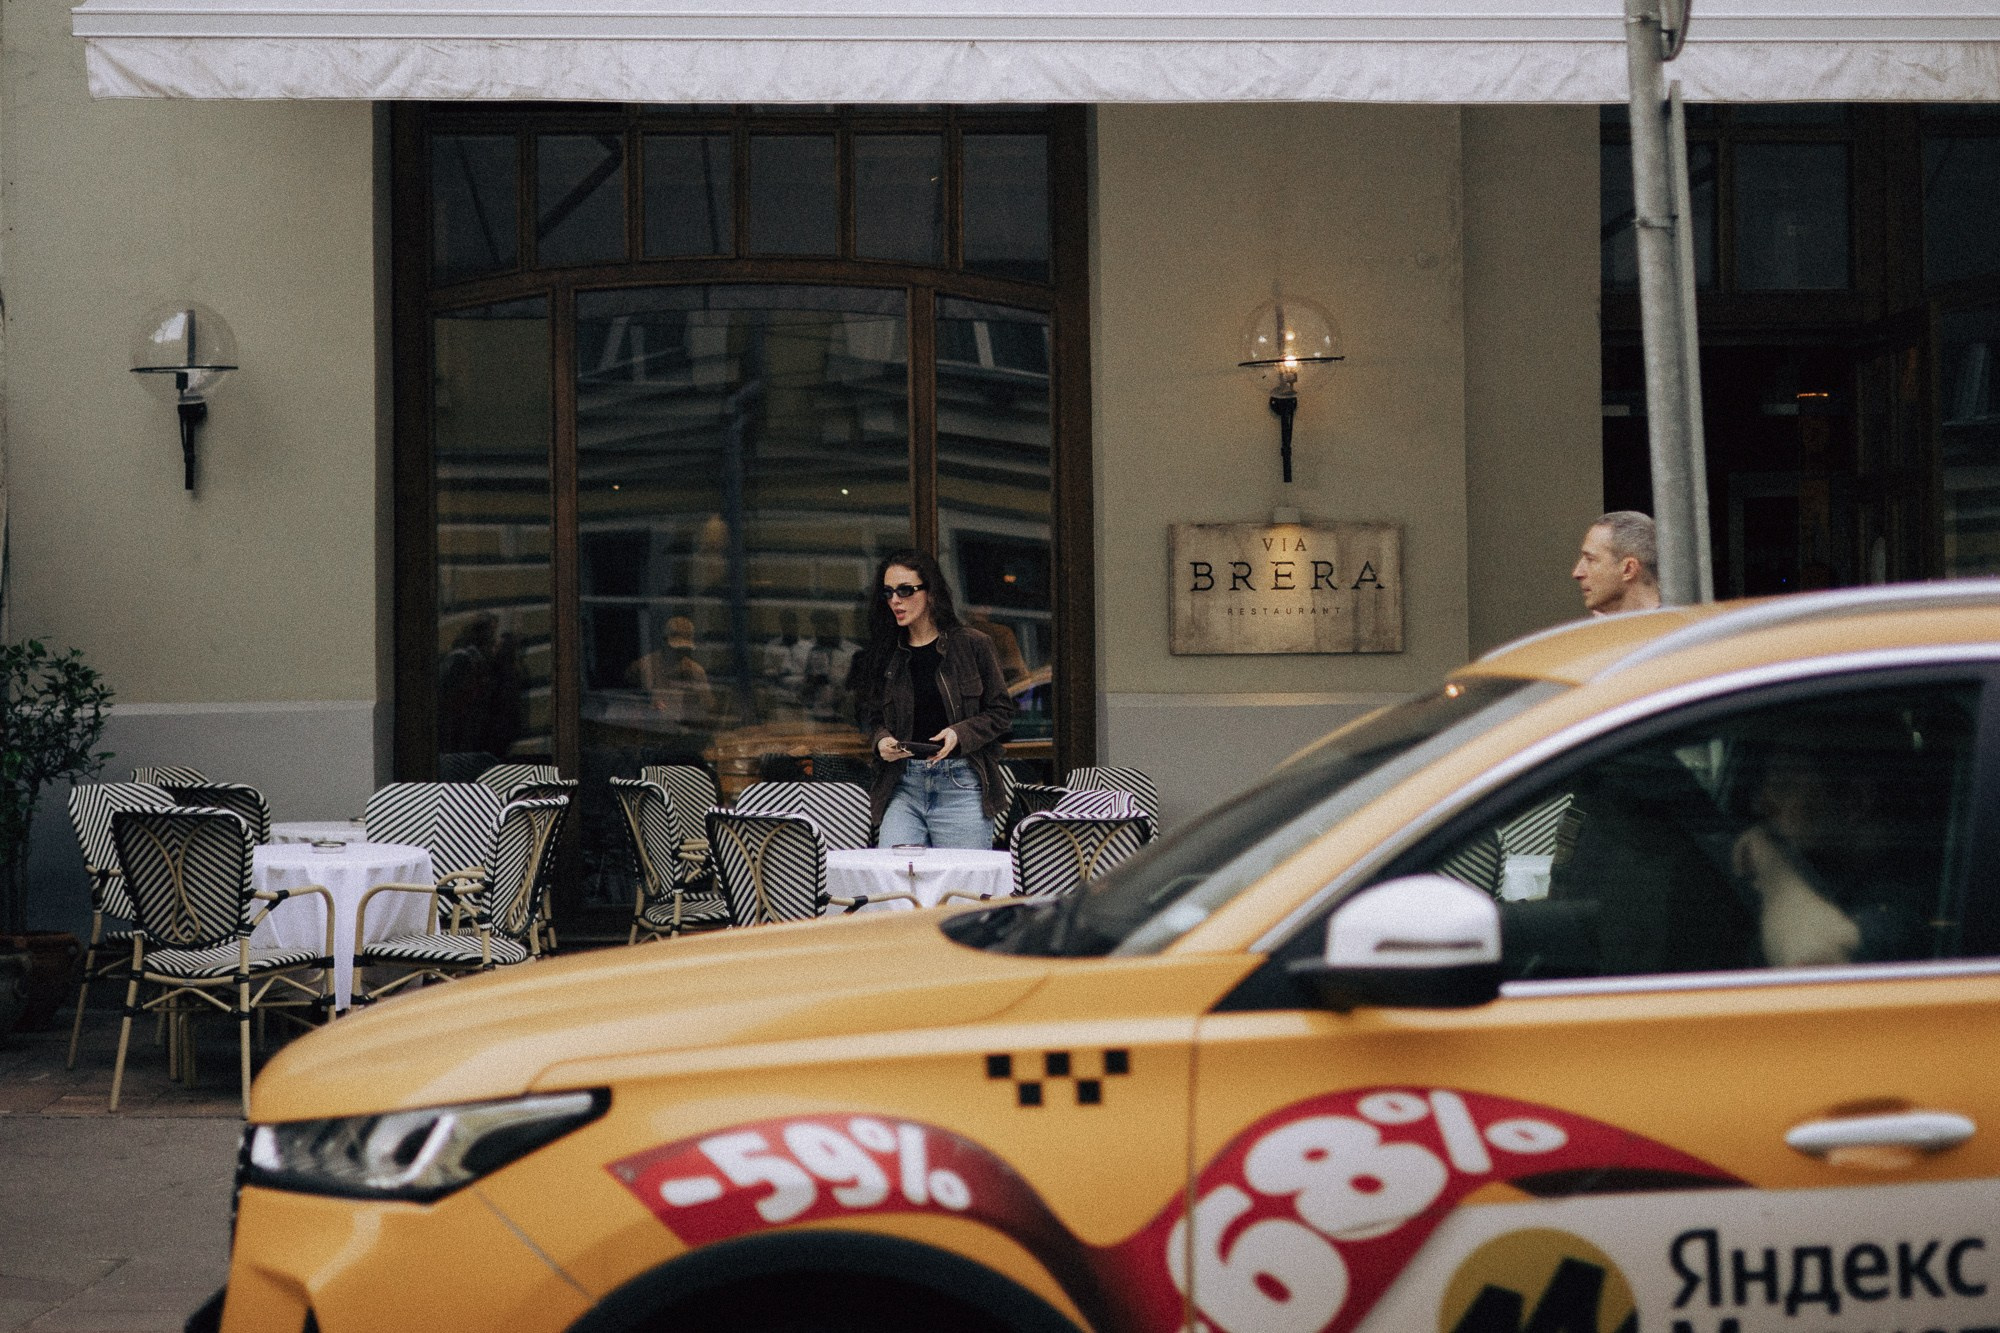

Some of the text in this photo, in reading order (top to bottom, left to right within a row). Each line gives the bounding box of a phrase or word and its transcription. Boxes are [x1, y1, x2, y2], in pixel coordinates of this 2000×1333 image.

[1262, 538, 1307, 552] VIA
[1190, 560, 1385, 592] BRERA
[1228, 607, 1341, 616] RESTAURANT
[660, 1117, 971, 1223] -59%
[1167, 1089, 1568, 1333] 68%
[1668, 1228, 1988, 1317] Яндекс
